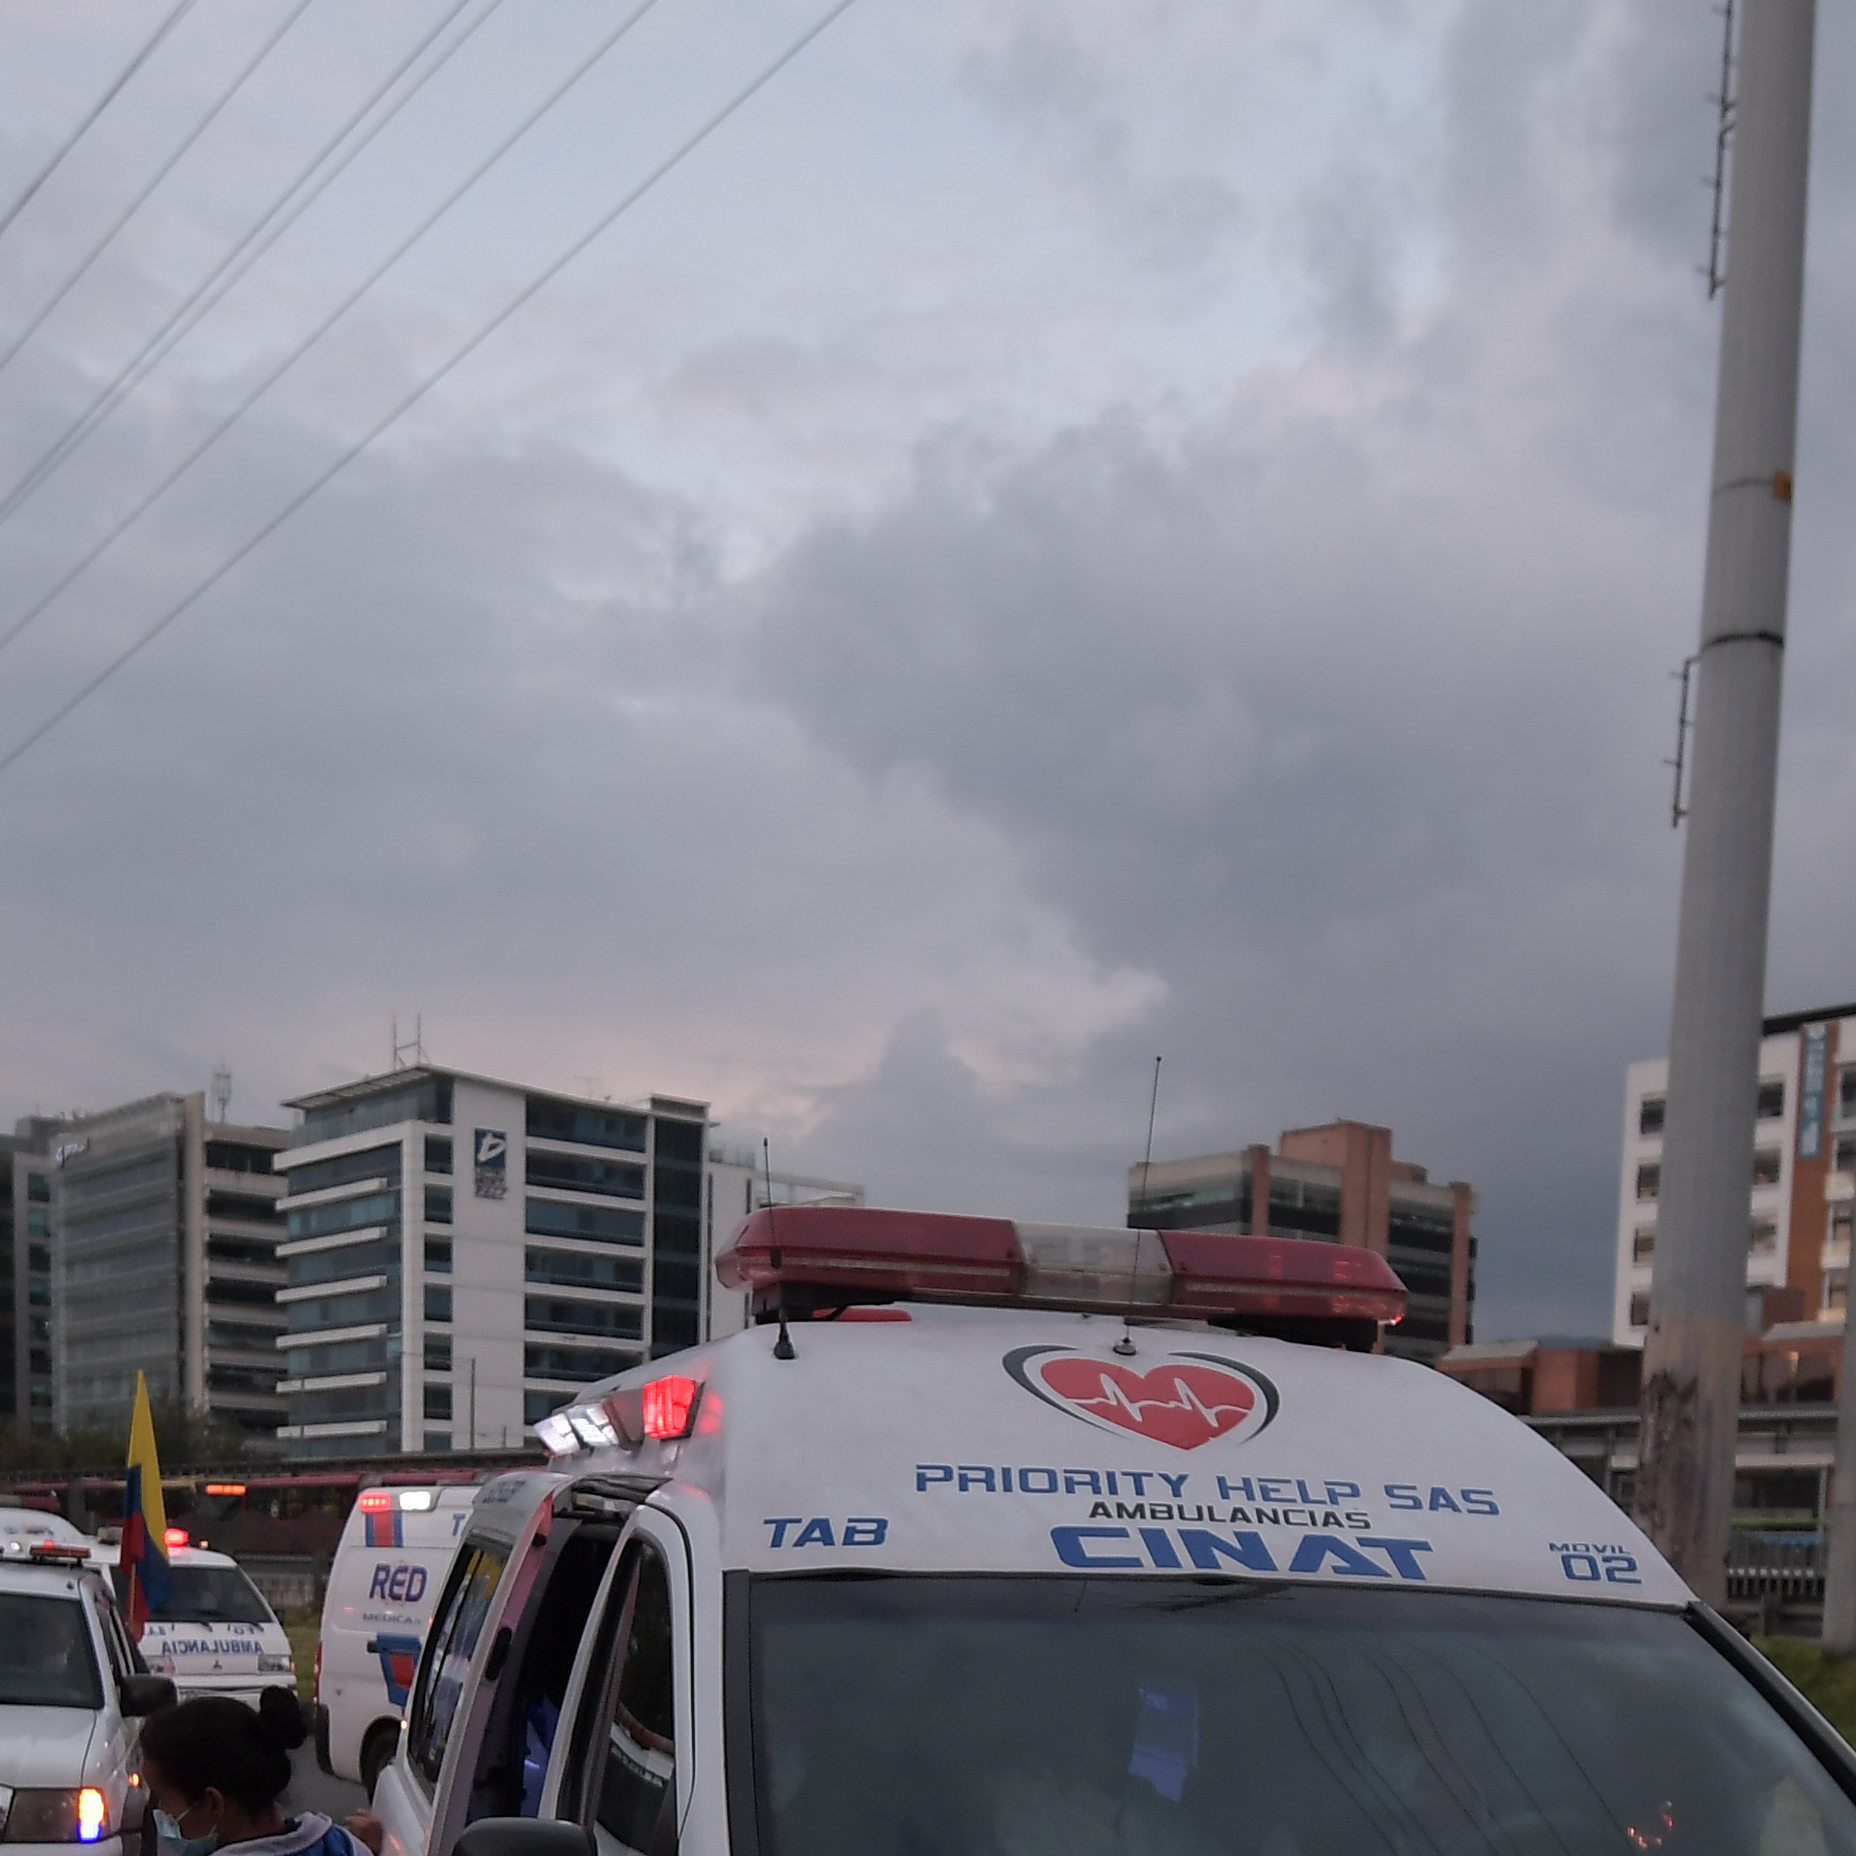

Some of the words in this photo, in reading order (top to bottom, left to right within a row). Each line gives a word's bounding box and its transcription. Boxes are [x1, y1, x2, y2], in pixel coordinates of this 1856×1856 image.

[915, 1464, 1190, 1500] PRIORITY
[1217, 1475, 1361, 1506] HELP
[1383, 1483, 1500, 1516] SAS
[1088, 1500, 1371, 1530] AMBULANCIAS
[763, 1517, 889, 1548] TAB
[1549, 1541, 1631, 1555] MOVIL
[1050, 1526, 1433, 1580] CINAT
[369, 1562, 427, 1602] RED
[1561, 1554, 1642, 1584] 02
